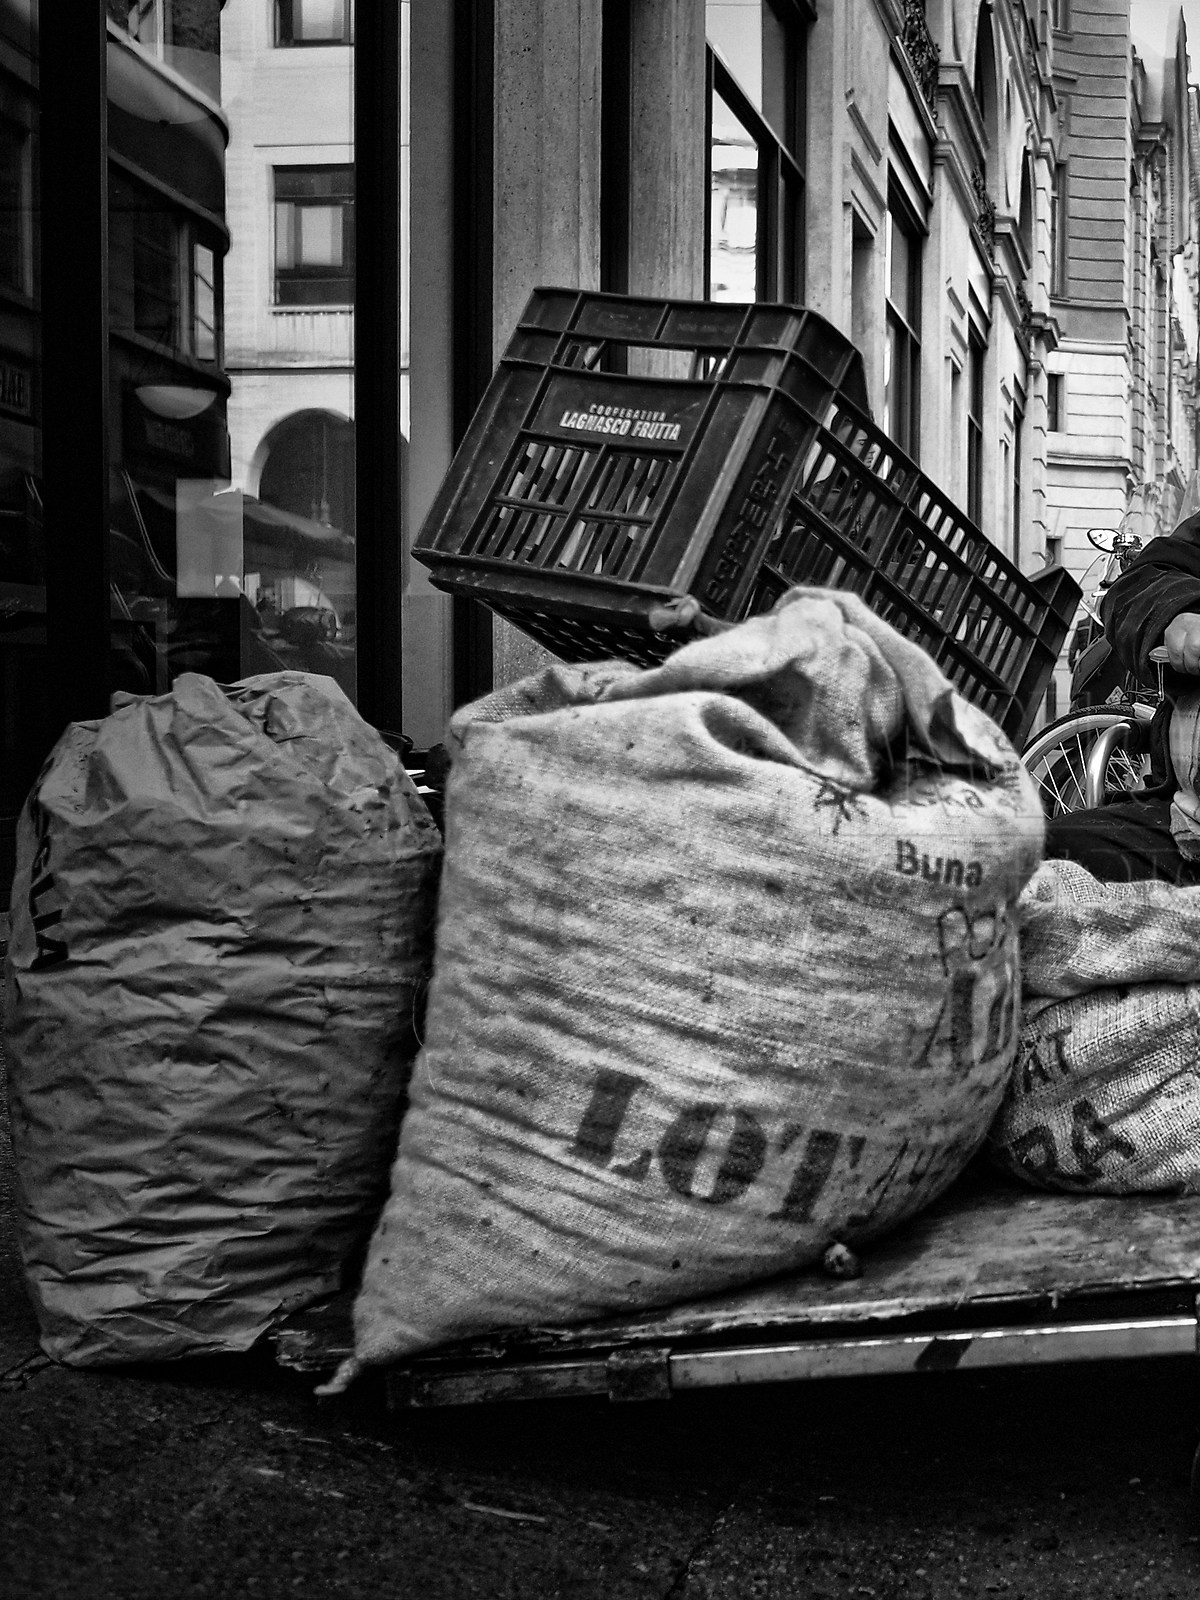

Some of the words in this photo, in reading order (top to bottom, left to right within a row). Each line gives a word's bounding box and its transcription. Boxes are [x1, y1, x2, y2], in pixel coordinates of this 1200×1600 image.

[559, 410, 632, 436] LAGNASCO
[631, 421, 682, 441] FRUTTA
[589, 403, 667, 422] COOPERATIVA
[896, 838, 983, 888] Buna
[569, 1068, 867, 1224] LOT
